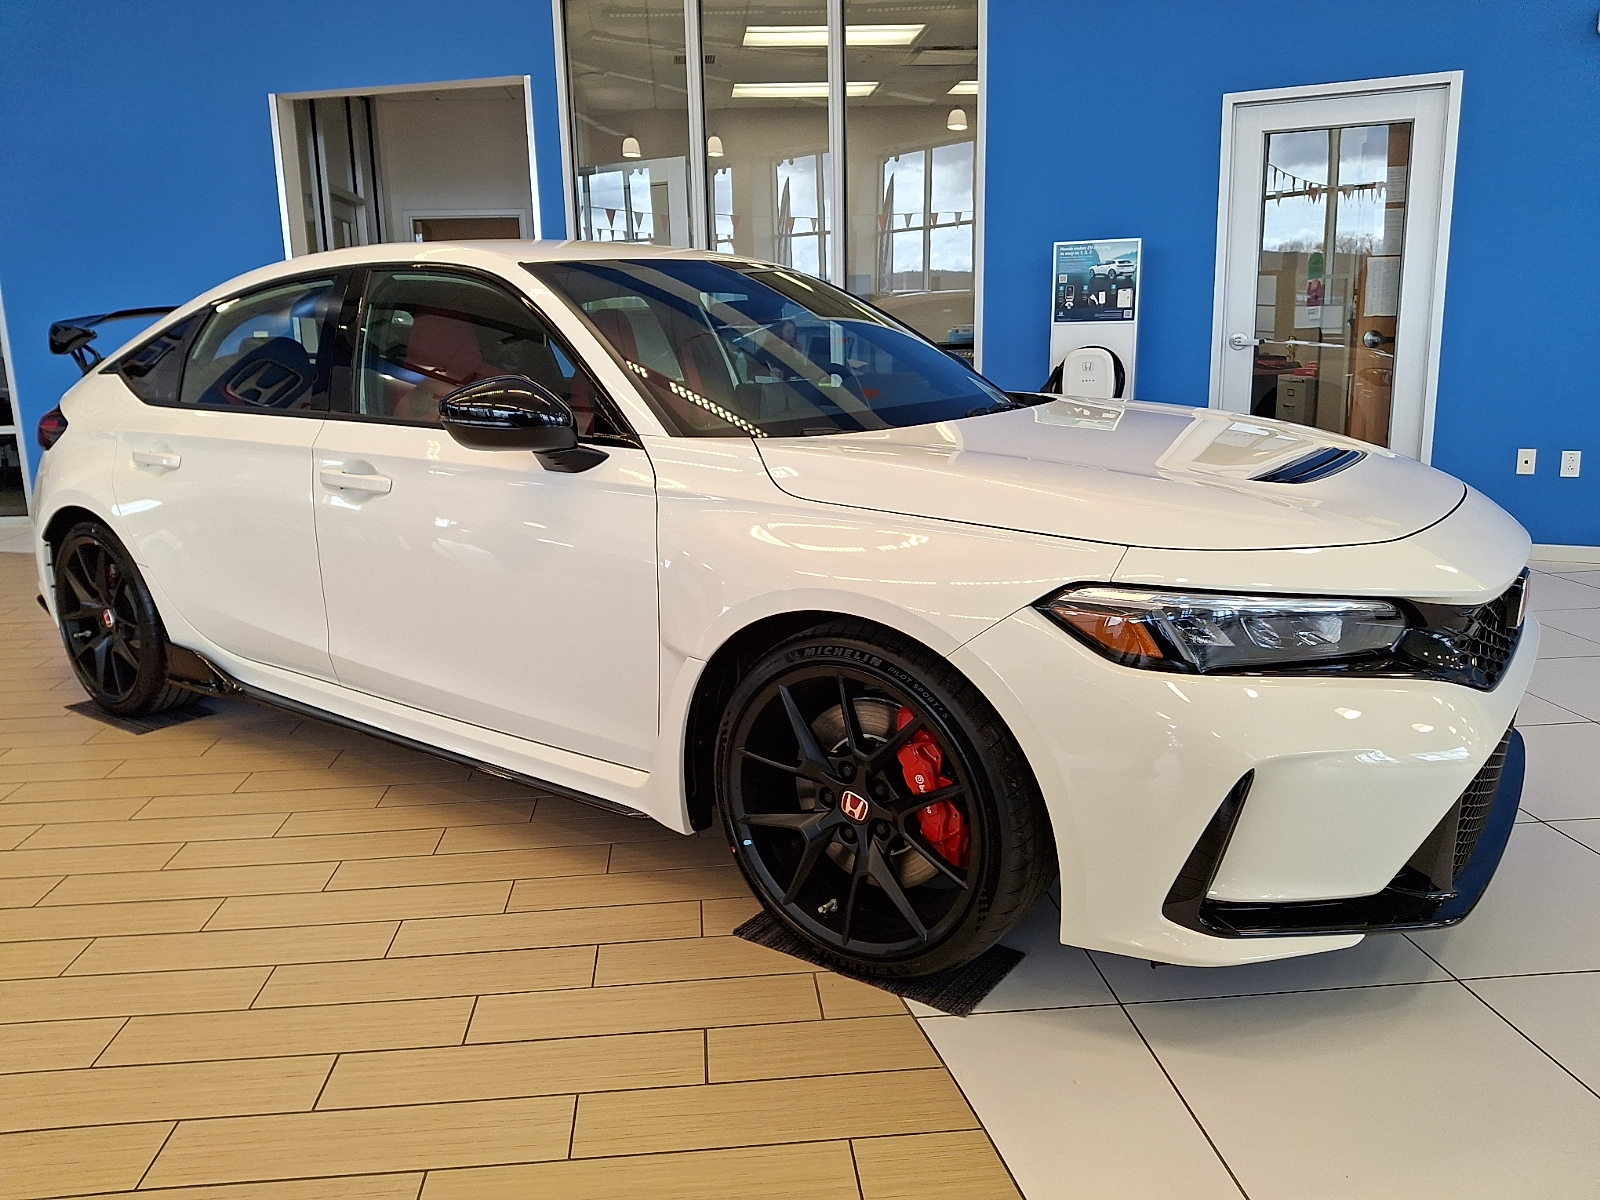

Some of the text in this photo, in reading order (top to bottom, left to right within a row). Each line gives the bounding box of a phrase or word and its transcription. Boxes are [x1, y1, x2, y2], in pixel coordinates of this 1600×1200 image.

[804, 647, 883, 667] MICHELIN
[888, 667, 912, 684] PILOT
[912, 683, 940, 706] SPORT
